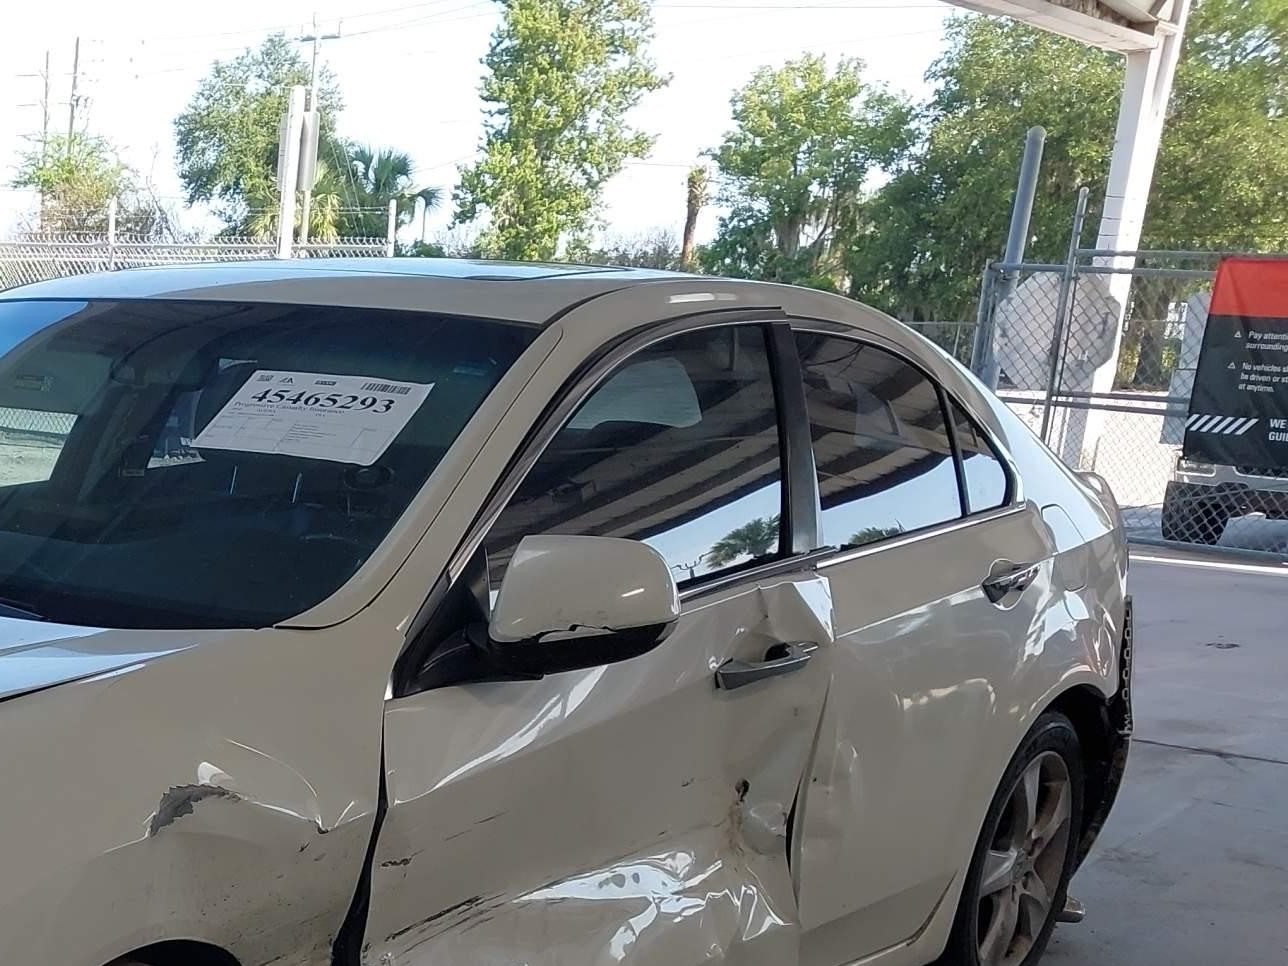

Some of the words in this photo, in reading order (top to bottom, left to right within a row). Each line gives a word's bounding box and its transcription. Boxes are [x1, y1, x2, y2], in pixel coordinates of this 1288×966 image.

[1248, 330, 1263, 341] Pay
[1242, 361, 1252, 370] No
[1253, 363, 1281, 373] vehicles
[1240, 372, 1249, 380] be
[1249, 373, 1271, 382] driven
[251, 388, 395, 414] 45465293
[1269, 418, 1288, 429] WE
